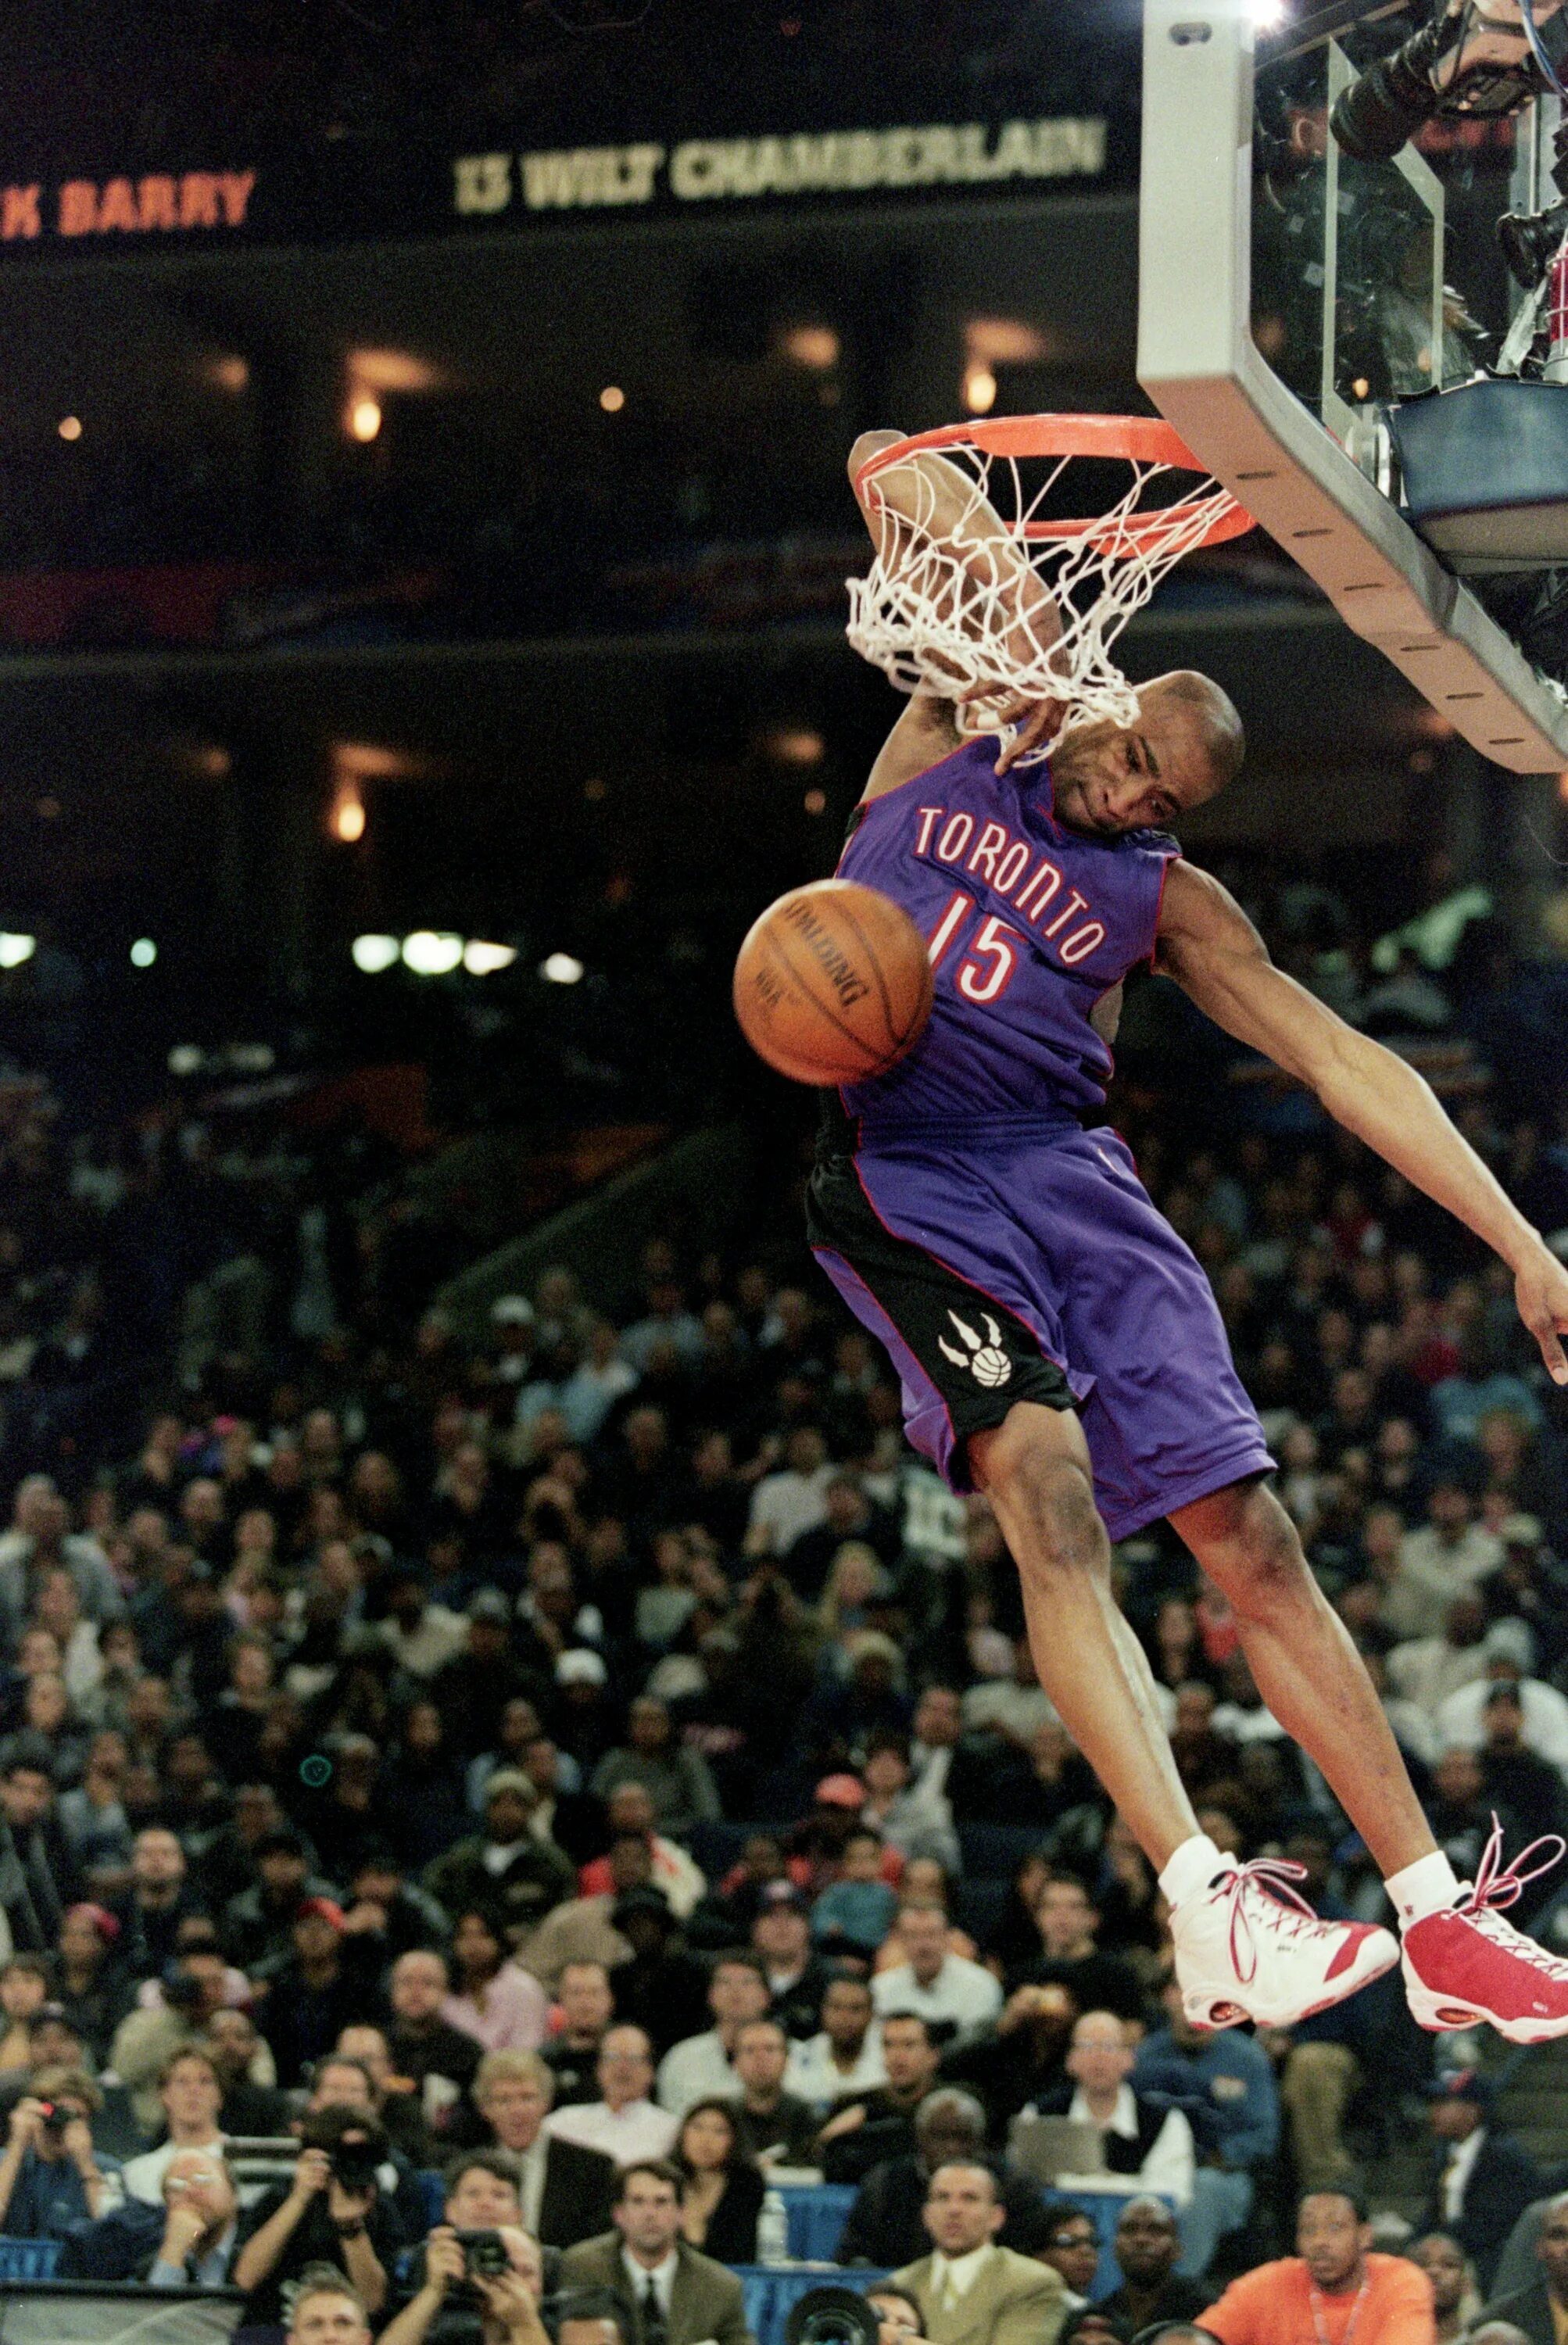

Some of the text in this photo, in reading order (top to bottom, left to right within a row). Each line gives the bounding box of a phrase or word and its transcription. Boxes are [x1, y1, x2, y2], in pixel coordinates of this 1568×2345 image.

[59, 169, 256, 235] BARRY
[521, 144, 663, 209] WILT
[670, 118, 1105, 199] CHAMBERLAIN
[915, 807, 1106, 967] TORONTO
[783, 900, 870, 1007] SPALDING
[929, 890, 1028, 1004] 15
